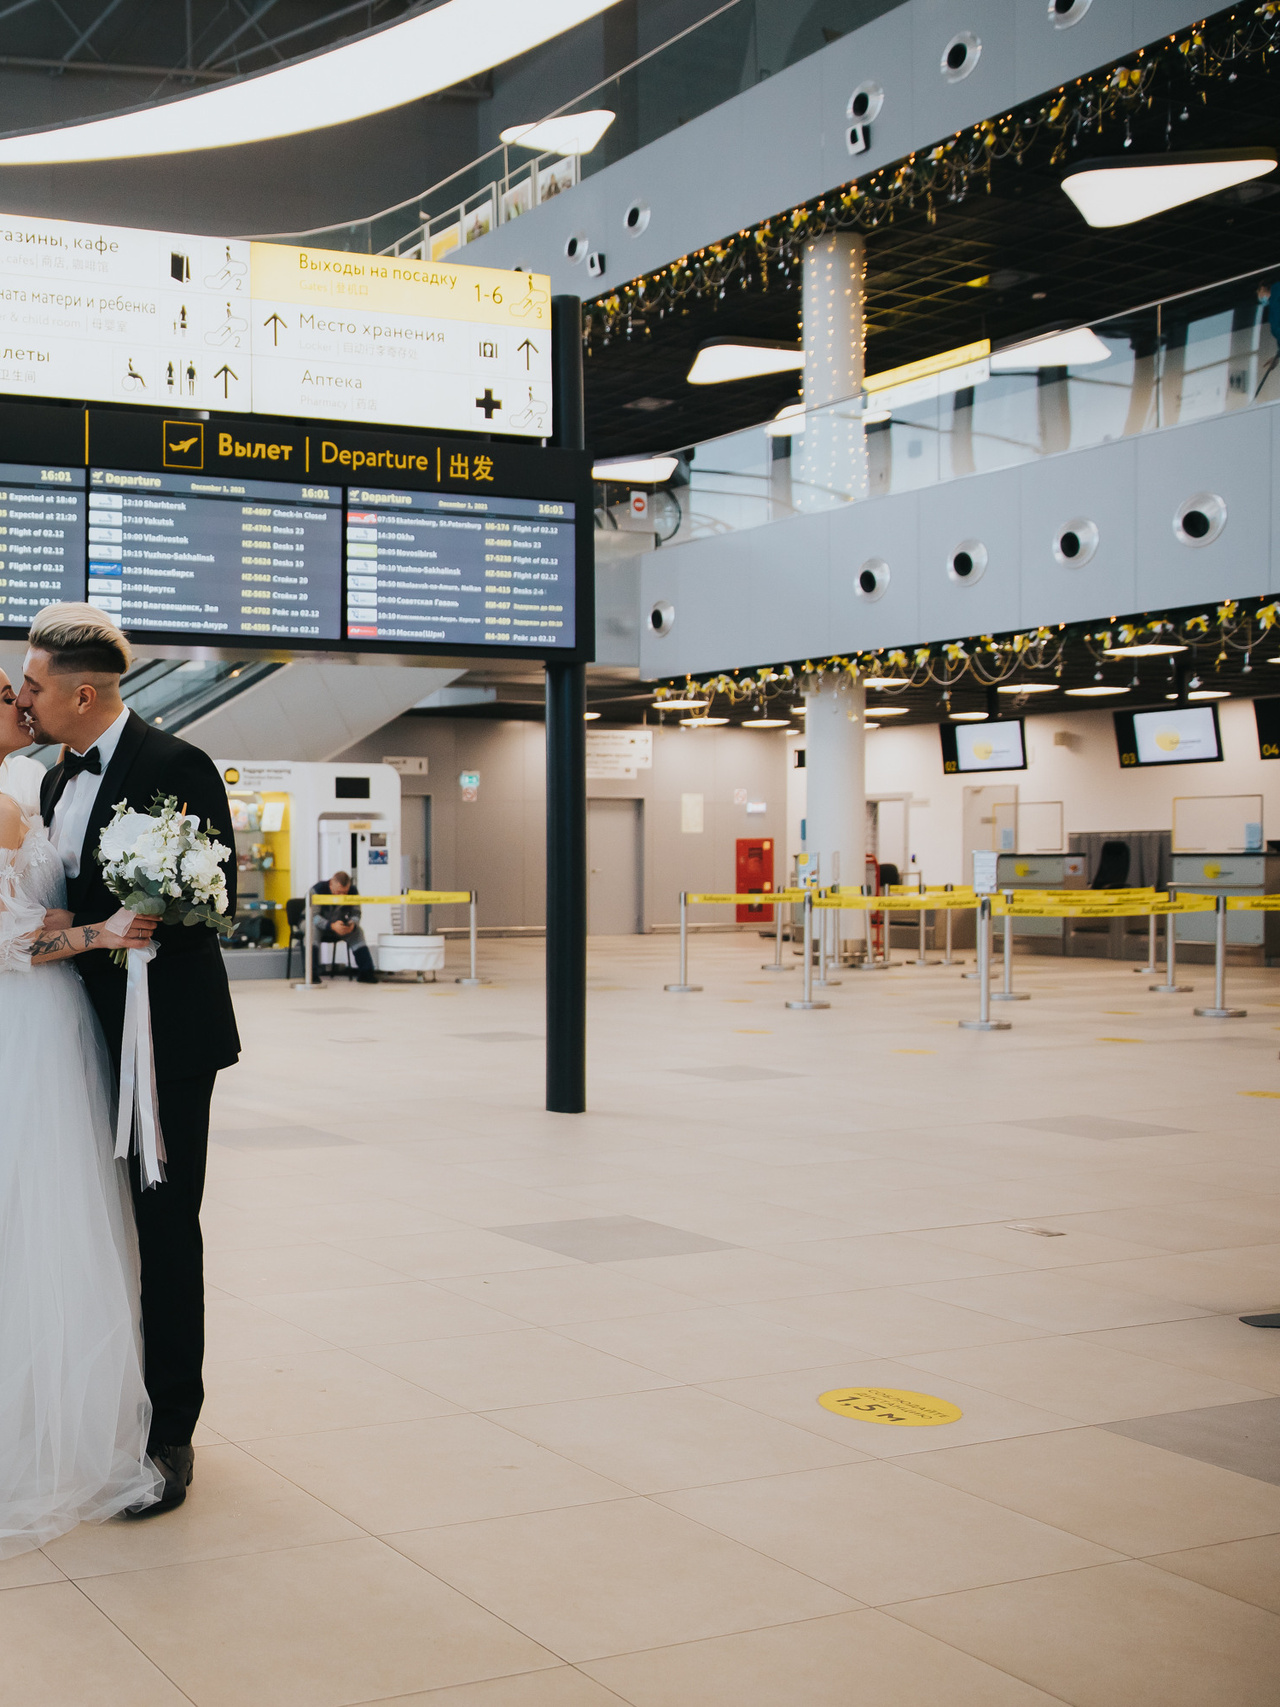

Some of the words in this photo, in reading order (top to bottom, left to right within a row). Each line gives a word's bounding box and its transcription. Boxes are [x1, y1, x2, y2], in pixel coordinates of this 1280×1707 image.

[73, 235, 119, 255] кафе
[299, 253, 365, 276] Выходы
[370, 266, 388, 279] на
[393, 269, 458, 290] посадку
[236, 278, 242, 291] 2
[474, 284, 503, 304] 1-6
[31, 291, 82, 310] матери
[86, 296, 95, 308] и
[99, 295, 156, 314] ребенка
[536, 307, 542, 318] 3
[299, 312, 357, 334] Место
[362, 324, 446, 343] хранения
[234, 336, 240, 348] 2
[301, 370, 362, 389] Аптека
[537, 417, 543, 429] 2
[218, 432, 293, 460] Вылет
[321, 440, 429, 471] Departure
[449, 453, 494, 481] 出发
[40, 470, 72, 482] 16:01
[105, 473, 162, 488] Departure
[302, 488, 330, 500] 16:01
[9, 493, 44, 503] Expected
[362, 491, 412, 505] Departure
[538, 504, 564, 515] 16:01
[144, 533, 189, 544] Vladivostok
